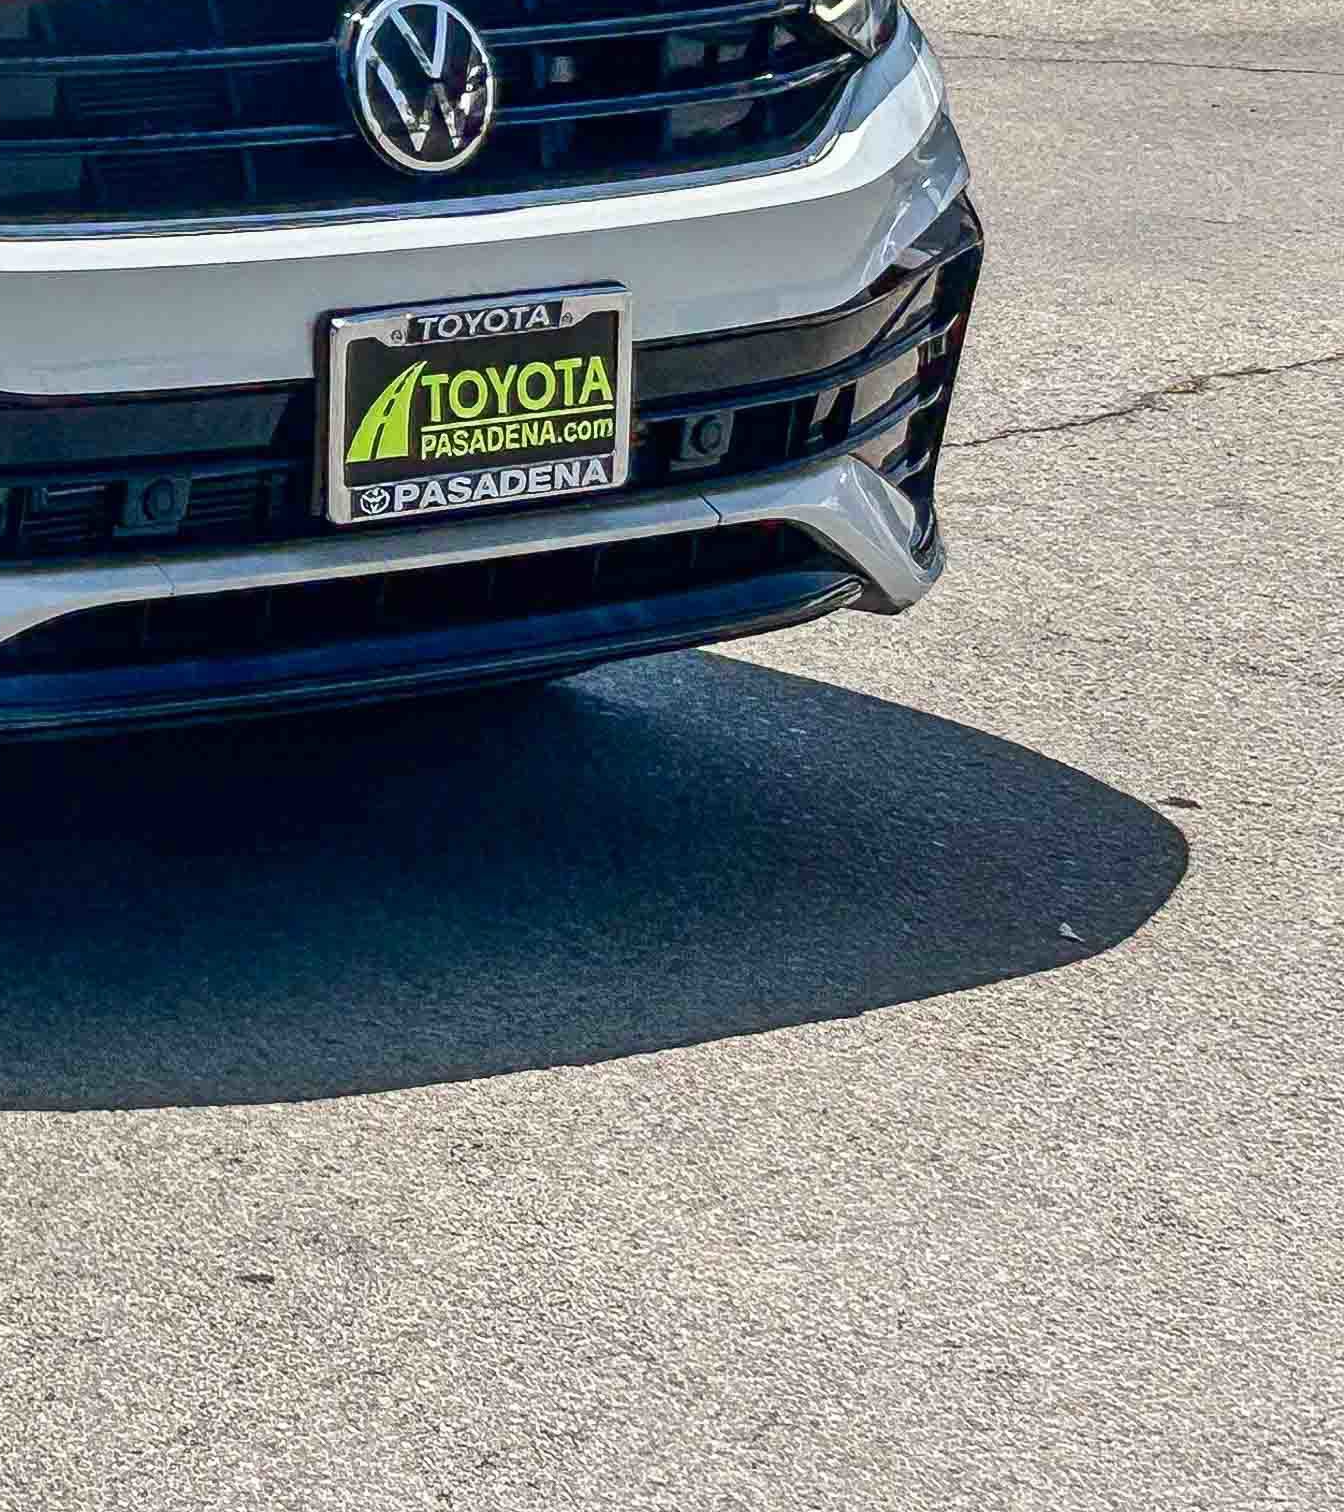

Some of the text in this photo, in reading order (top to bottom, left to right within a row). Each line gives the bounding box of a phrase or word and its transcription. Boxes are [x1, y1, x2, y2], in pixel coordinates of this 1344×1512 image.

[416, 303, 551, 340] TOYOTA
[421, 355, 614, 423] TOYOTA
[421, 416, 615, 462] PASADENA.com
[394, 458, 609, 512] PASADENA
